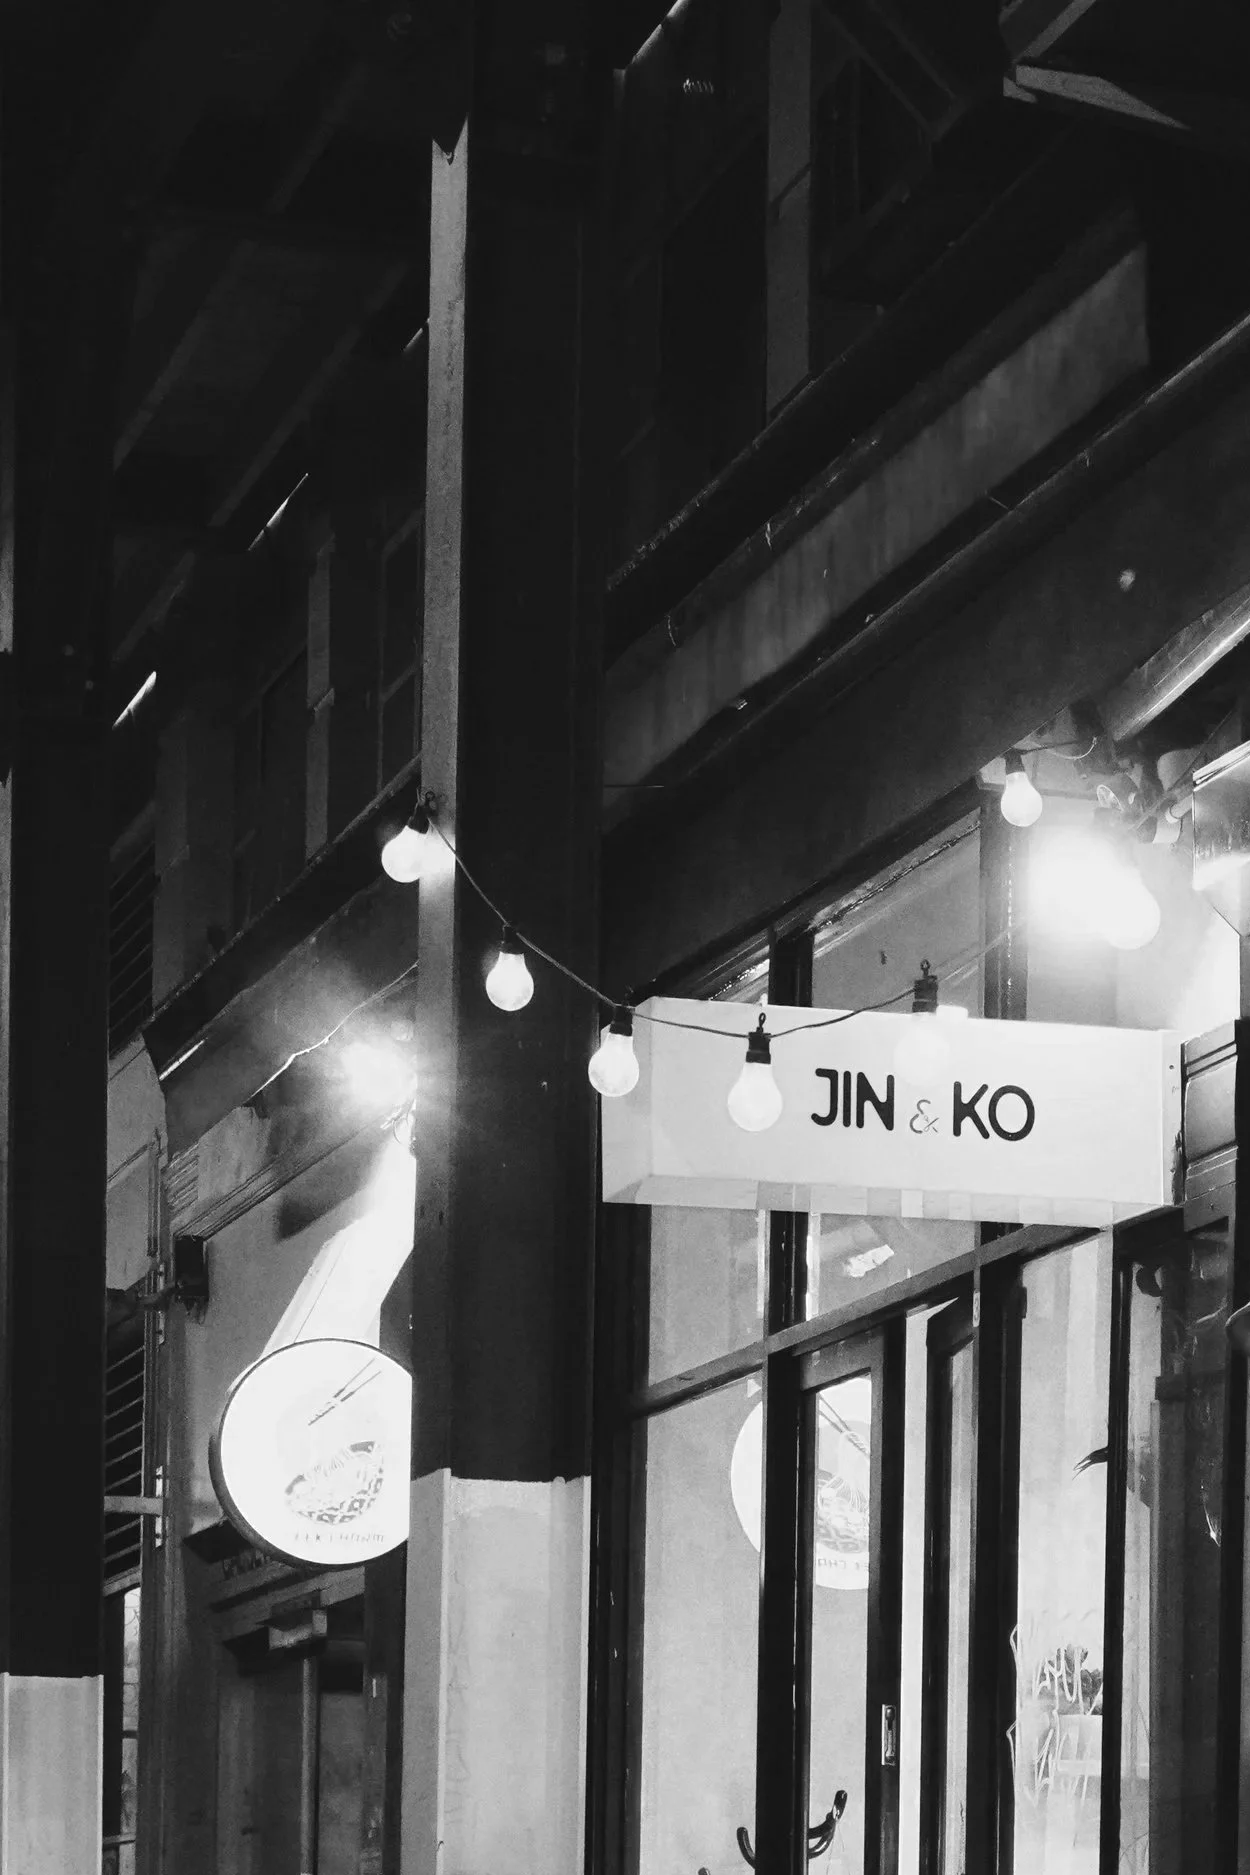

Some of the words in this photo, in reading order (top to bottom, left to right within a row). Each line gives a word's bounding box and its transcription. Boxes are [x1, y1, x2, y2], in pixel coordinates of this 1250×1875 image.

[811, 1067, 894, 1132] JIN
[909, 1099, 939, 1135] &
[953, 1081, 1036, 1141] KO
